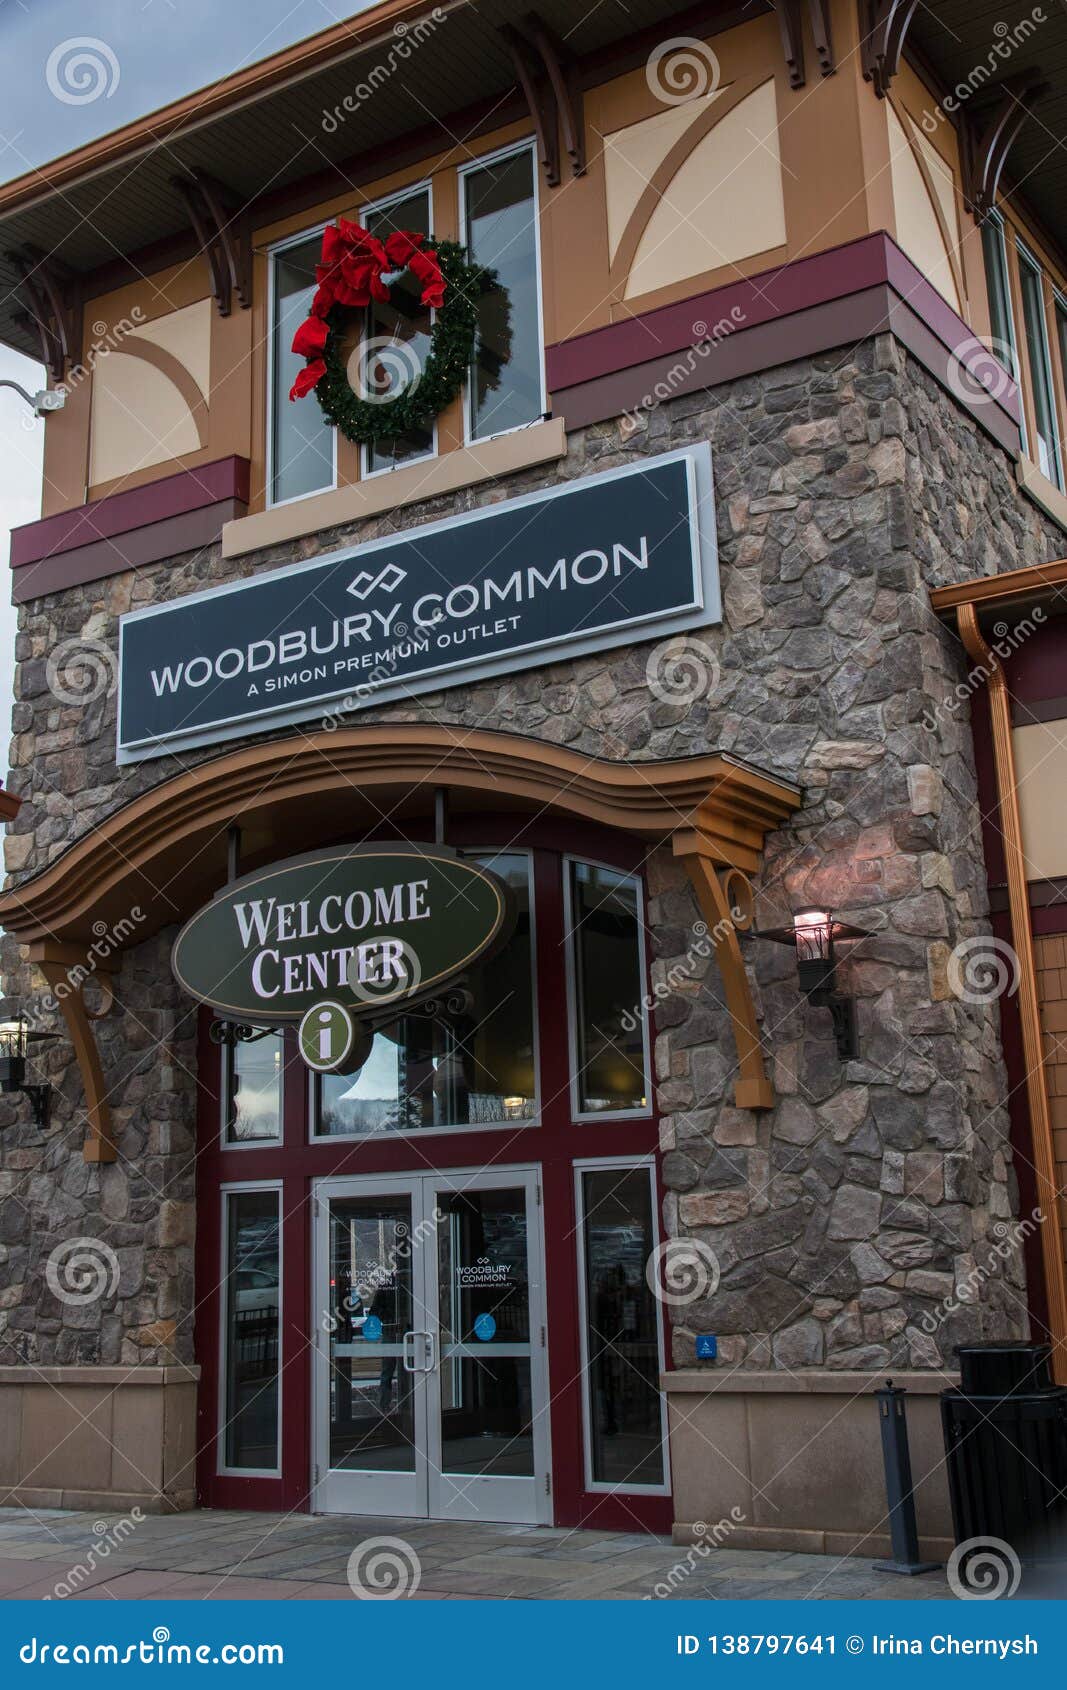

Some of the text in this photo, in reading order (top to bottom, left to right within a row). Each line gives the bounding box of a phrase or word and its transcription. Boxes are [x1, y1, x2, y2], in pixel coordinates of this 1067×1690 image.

[150, 536, 648, 697] WOODBURY COMMON
[247, 615, 521, 696] A SIMON PREMIUM OUTLET
[233, 879, 431, 949] WELCOME
[252, 940, 408, 998] CENTER
[456, 1265, 512, 1275] WOODBURY
[462, 1273, 507, 1283] COMMON
